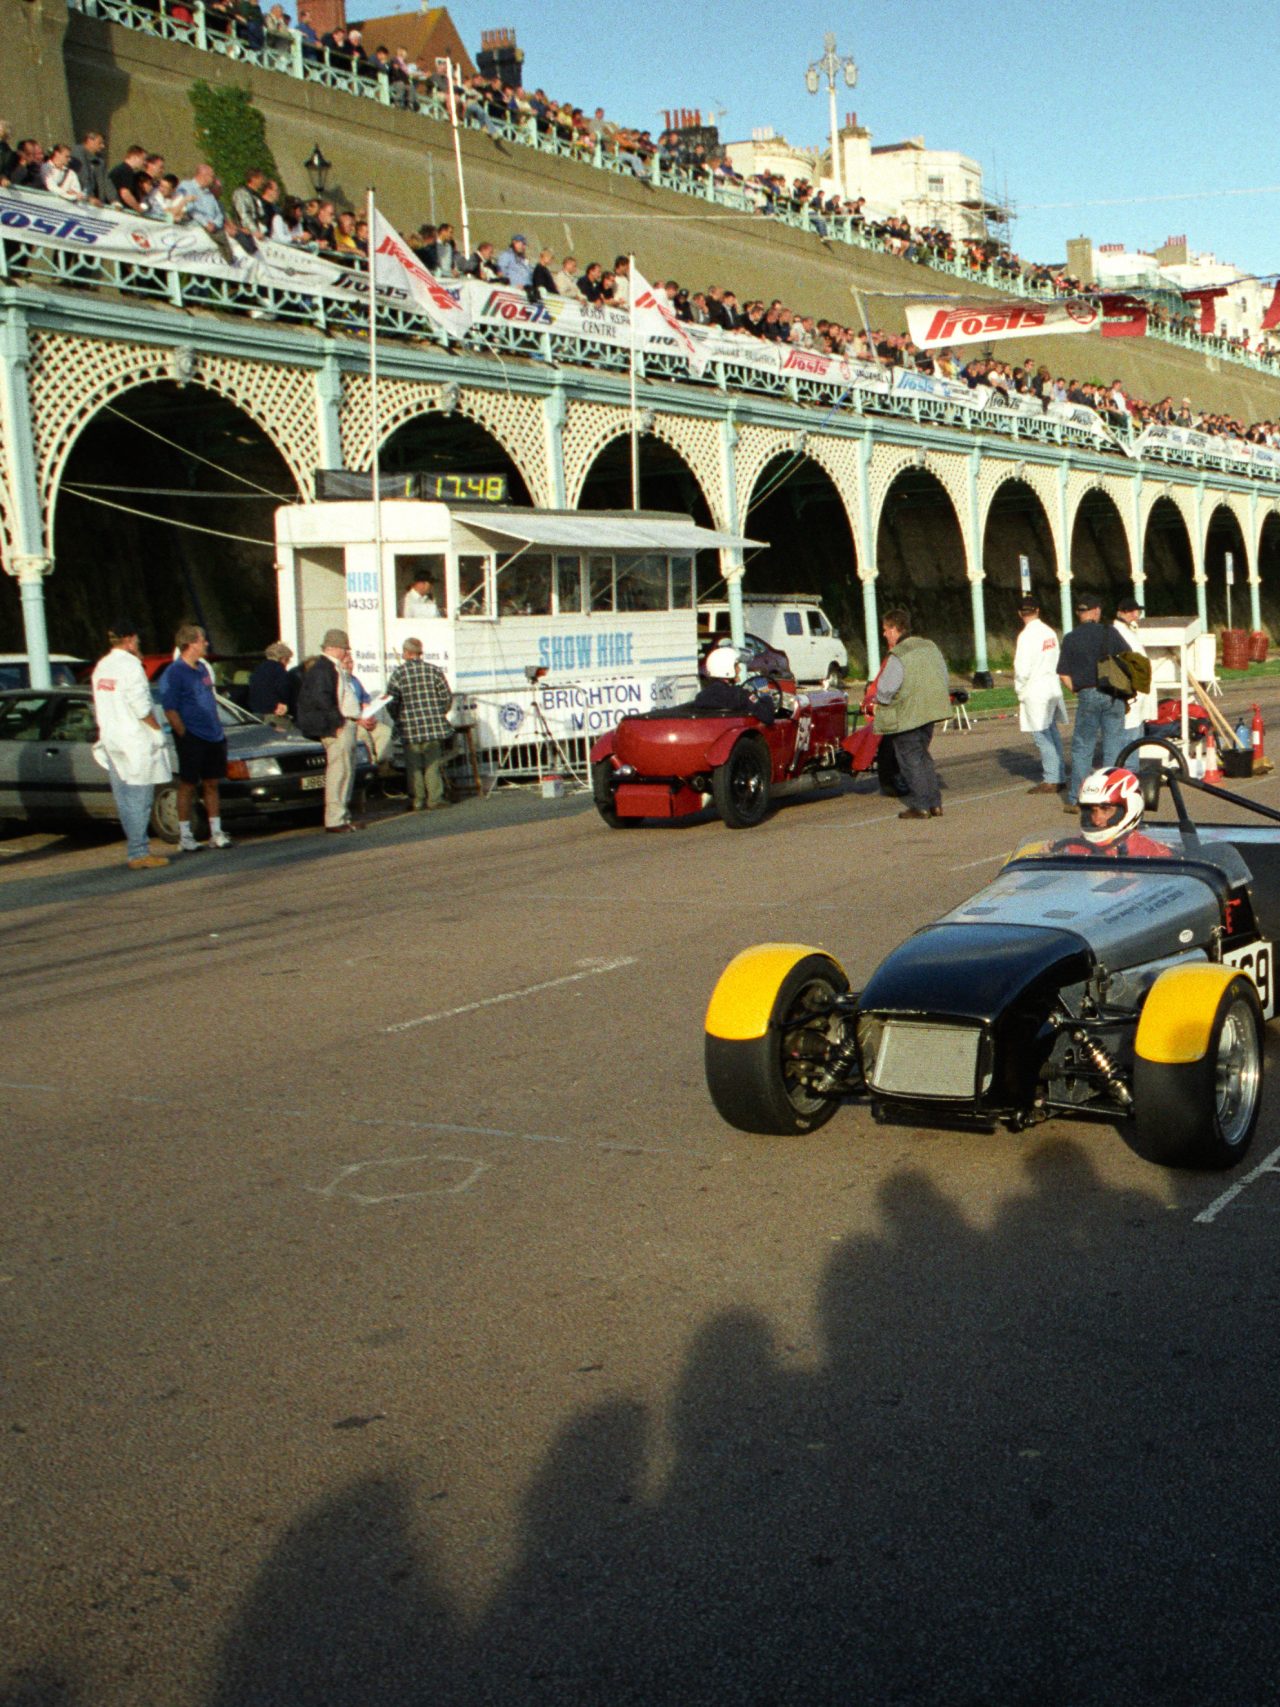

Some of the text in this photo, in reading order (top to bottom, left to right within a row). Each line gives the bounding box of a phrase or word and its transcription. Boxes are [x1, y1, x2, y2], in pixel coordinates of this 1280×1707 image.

[436, 475, 503, 501] 17.48
[538, 631, 634, 672] SHOW HIRE
[542, 683, 643, 711] BRIGHTON
[650, 685, 657, 702] &
